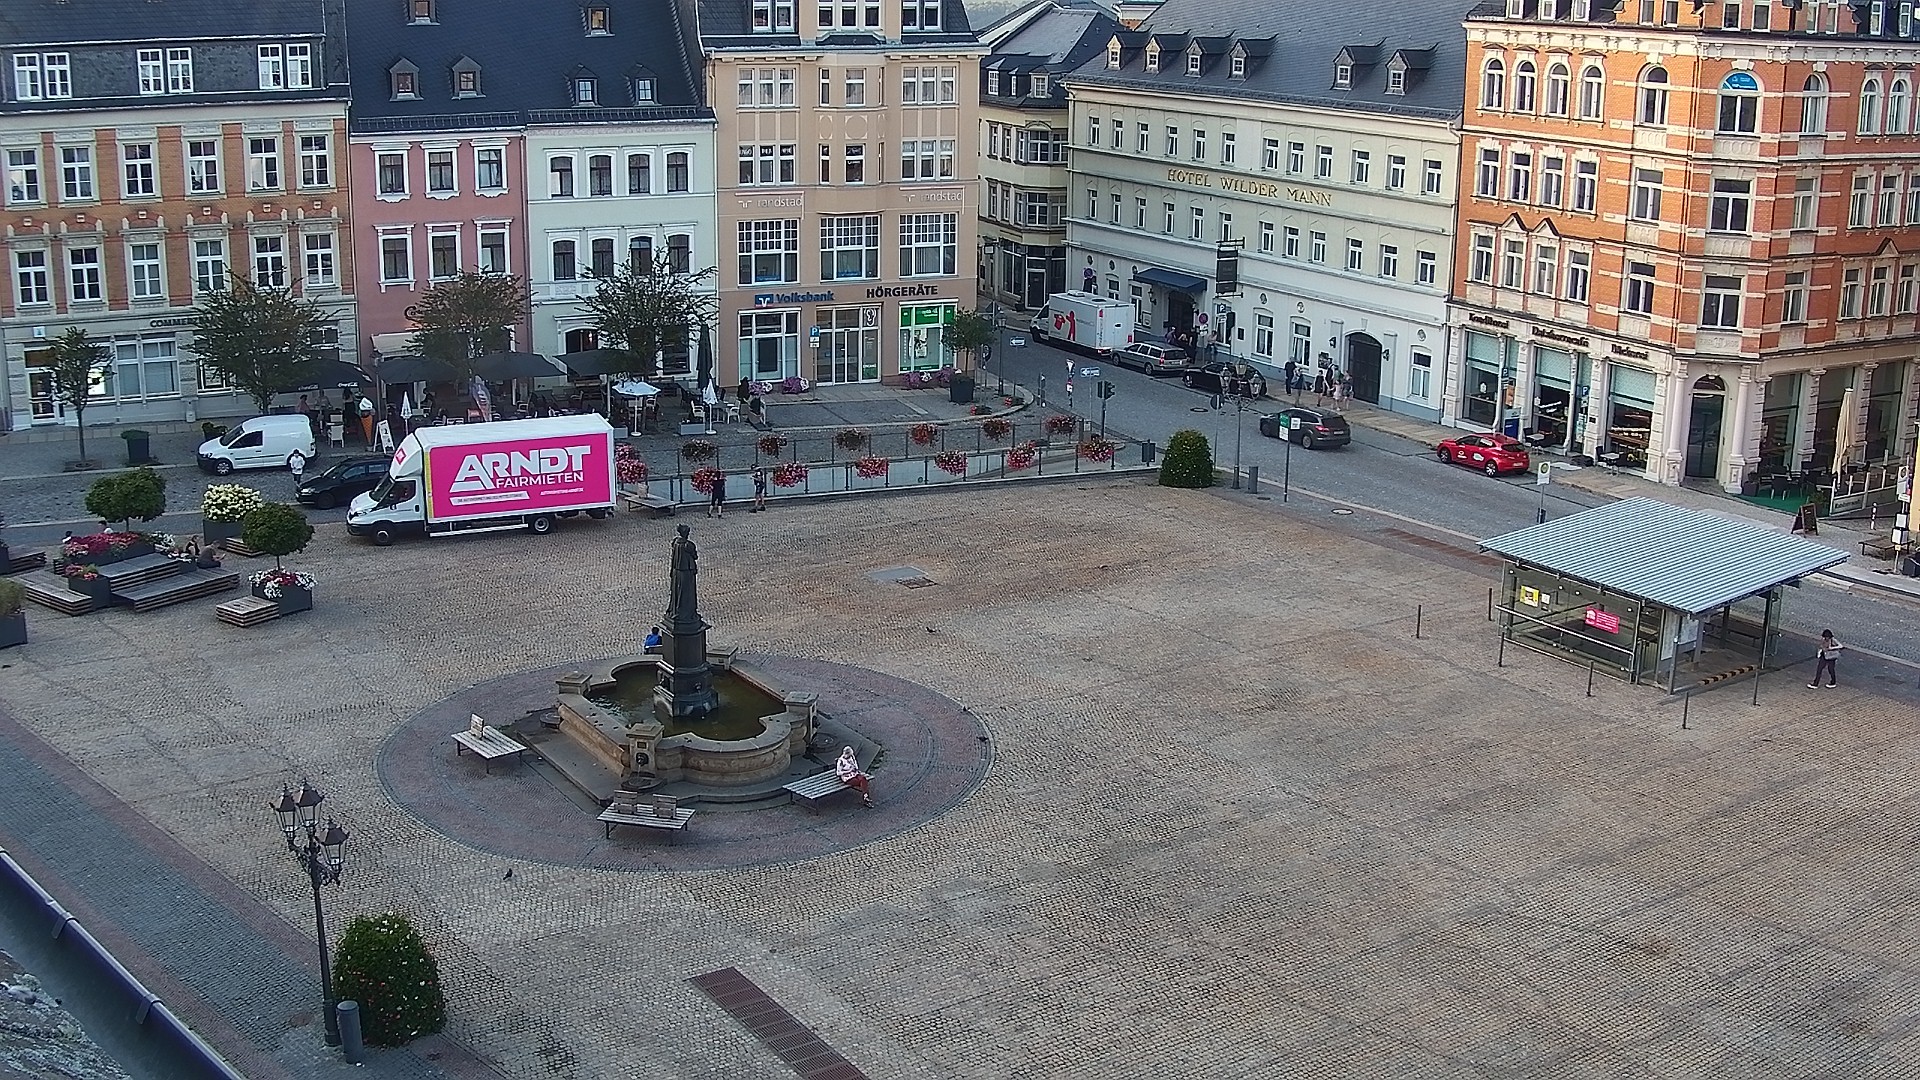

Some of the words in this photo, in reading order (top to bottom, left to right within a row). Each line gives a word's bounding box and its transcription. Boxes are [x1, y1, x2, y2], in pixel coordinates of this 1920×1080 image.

[1167, 168, 1212, 188] HOTEL
[1220, 175, 1279, 199] WILDER
[1286, 186, 1333, 208] MANN
[756, 195, 803, 209] randstad
[776, 290, 835, 304] Volksbank
[866, 284, 939, 299] HÖRGERÄTE
[811, 327, 818, 336] P
[449, 445, 592, 494] ARNDT
[496, 471, 584, 489] FAIRMIETEN
